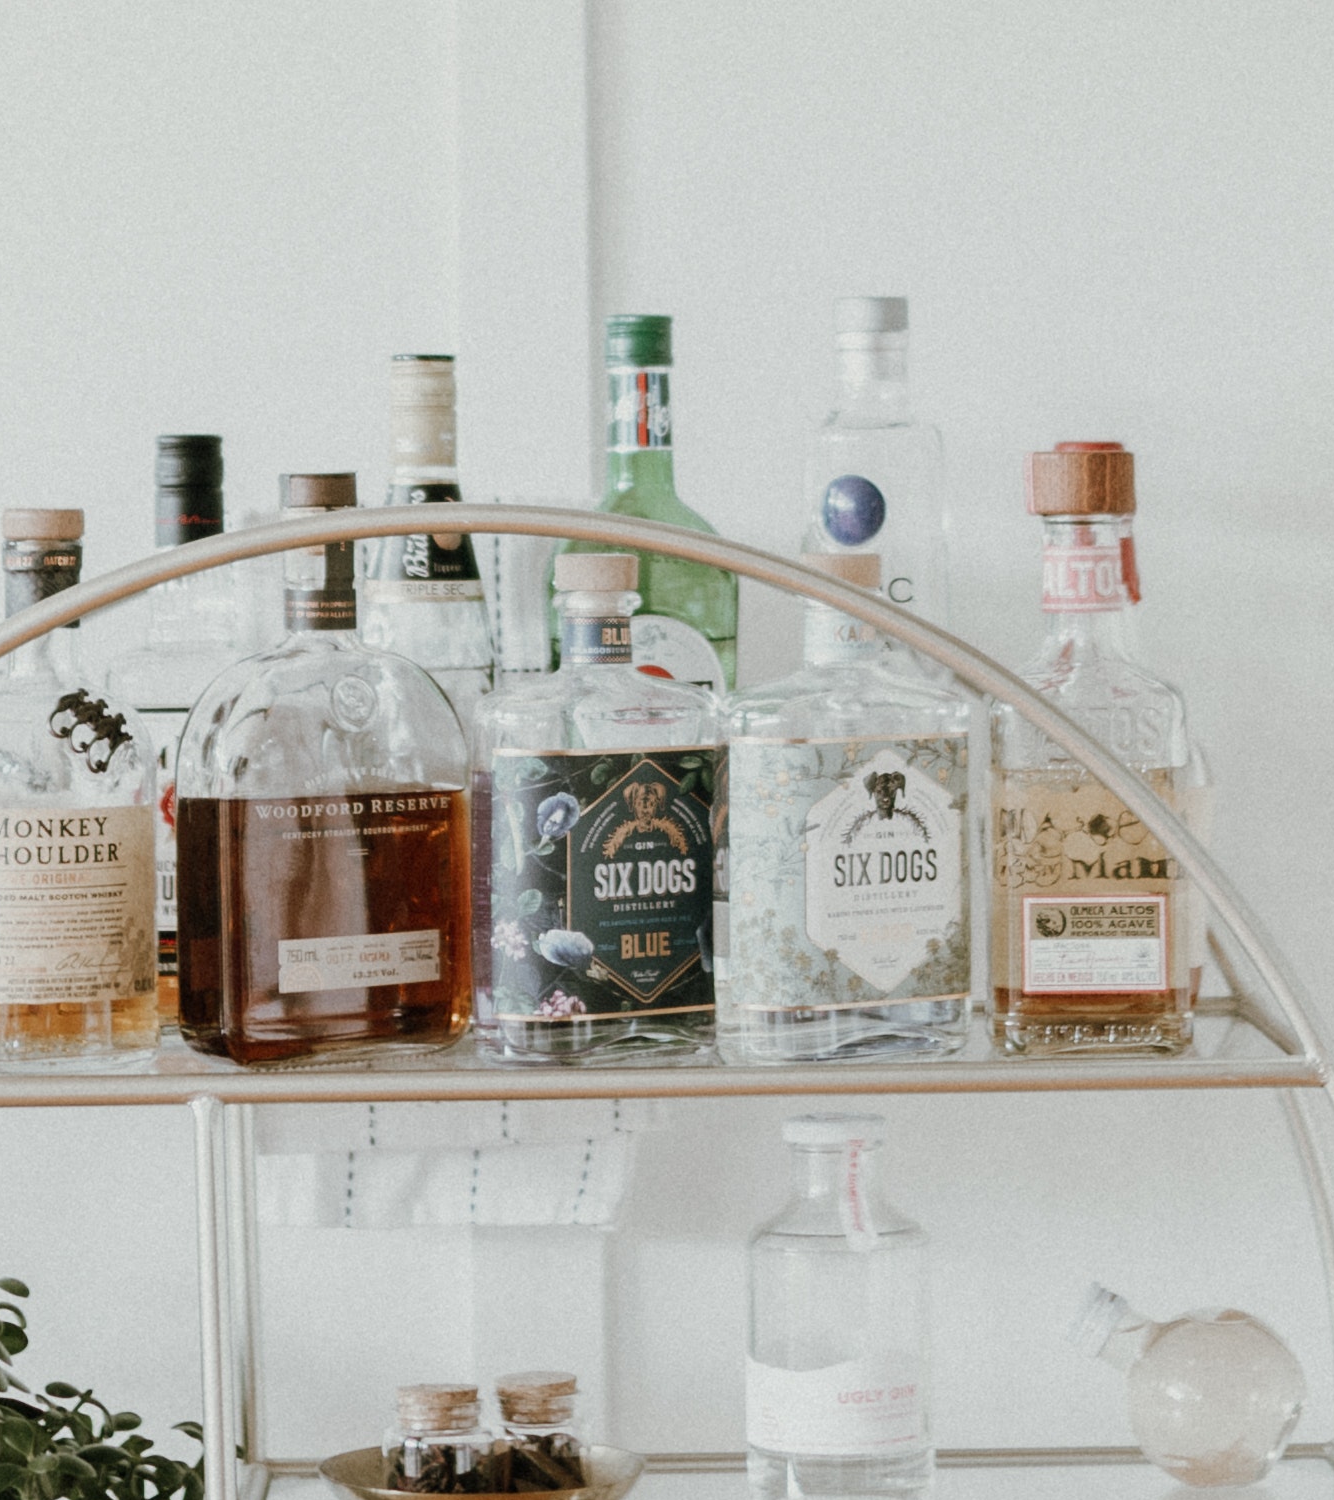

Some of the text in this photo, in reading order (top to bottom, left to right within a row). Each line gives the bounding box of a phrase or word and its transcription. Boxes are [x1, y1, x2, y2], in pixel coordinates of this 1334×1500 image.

[402, 583, 465, 595] TRIPLE SEC
[602, 627, 631, 645] BLU
[255, 797, 448, 819] WOODFORD RESERVE
[875, 831, 895, 839] GIN
[635, 841, 654, 850] GIN
[834, 848, 937, 887] SIX DOGS
[593, 858, 696, 900] SIX DOGS
[19, 893, 46, 901] MALT
[613, 900, 675, 912] DISTILLERY
[1070, 905, 1155, 916] OLMECA ALTOS
[1071, 919, 1155, 929] 100% AGAVE
[620, 931, 671, 960] BLUE
